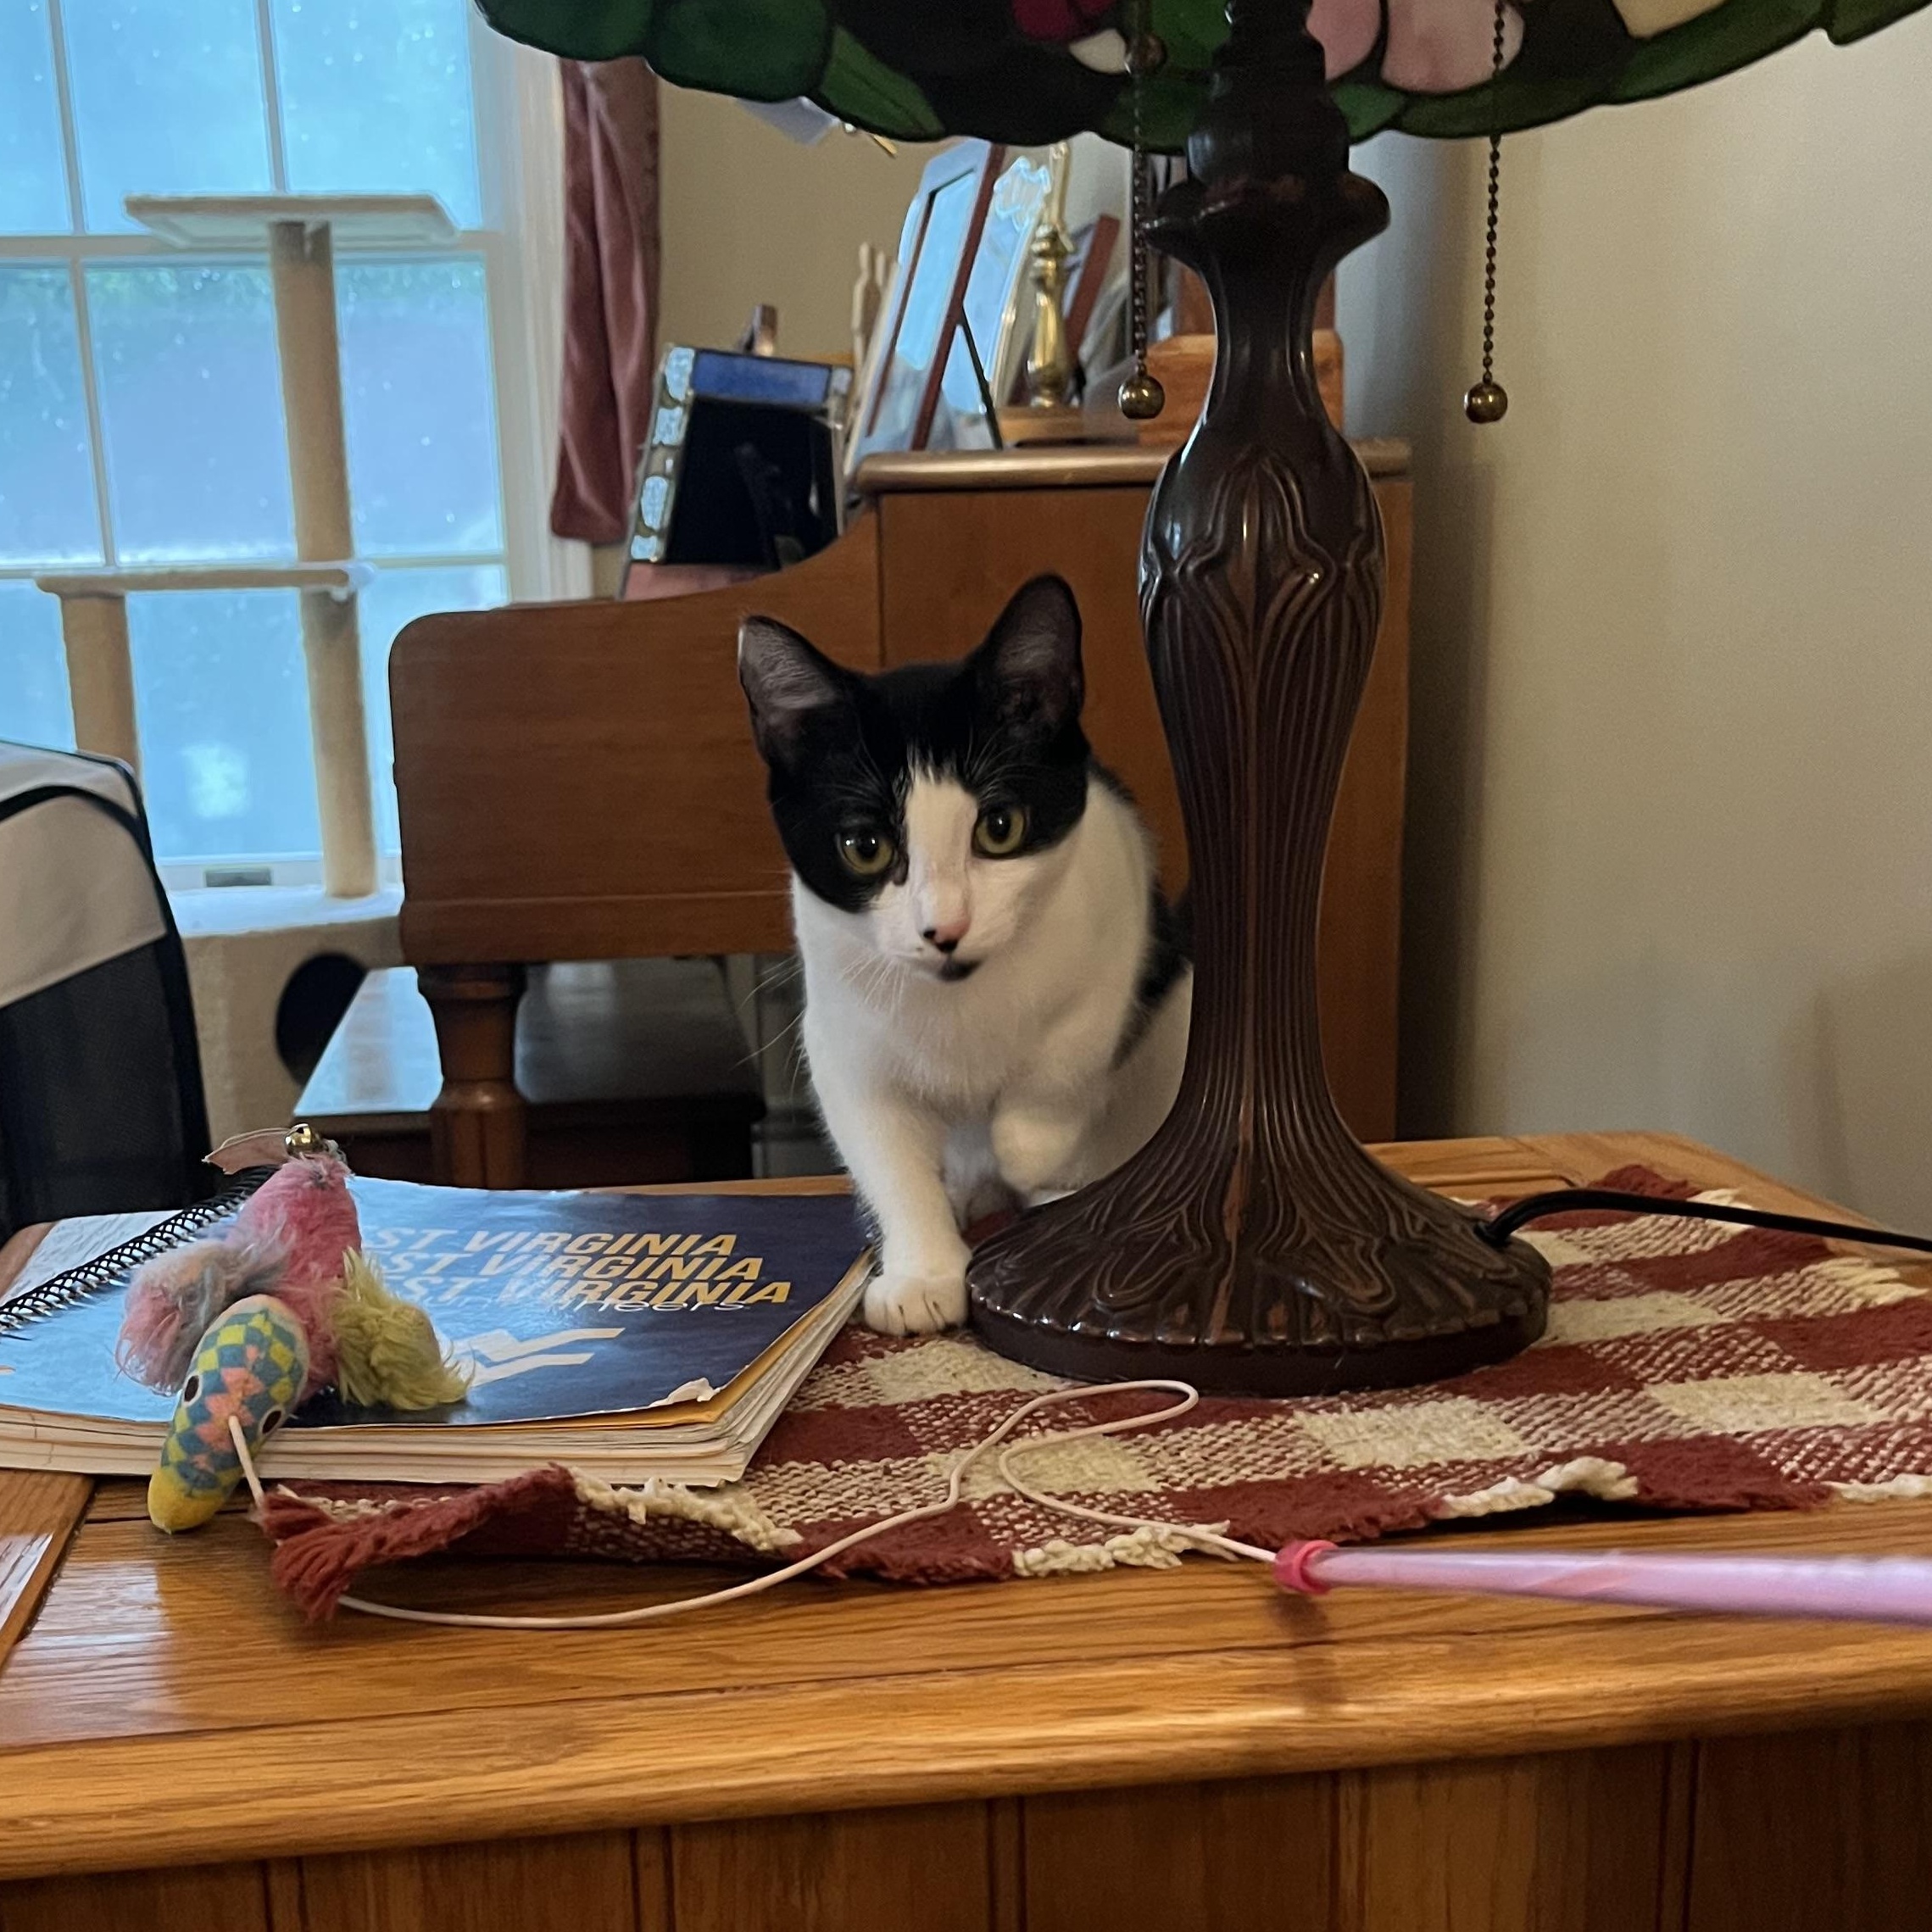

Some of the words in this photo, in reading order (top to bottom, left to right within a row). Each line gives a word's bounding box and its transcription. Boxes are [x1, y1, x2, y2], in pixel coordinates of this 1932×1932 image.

[363, 1228, 459, 1250] ST
[464, 1230, 738, 1256] VIRGINIA
[370, 1250, 473, 1274] ST
[479, 1253, 763, 1281] VIRGINIA
[384, 1275, 490, 1302] ST
[496, 1278, 792, 1305] VIRGINIA
